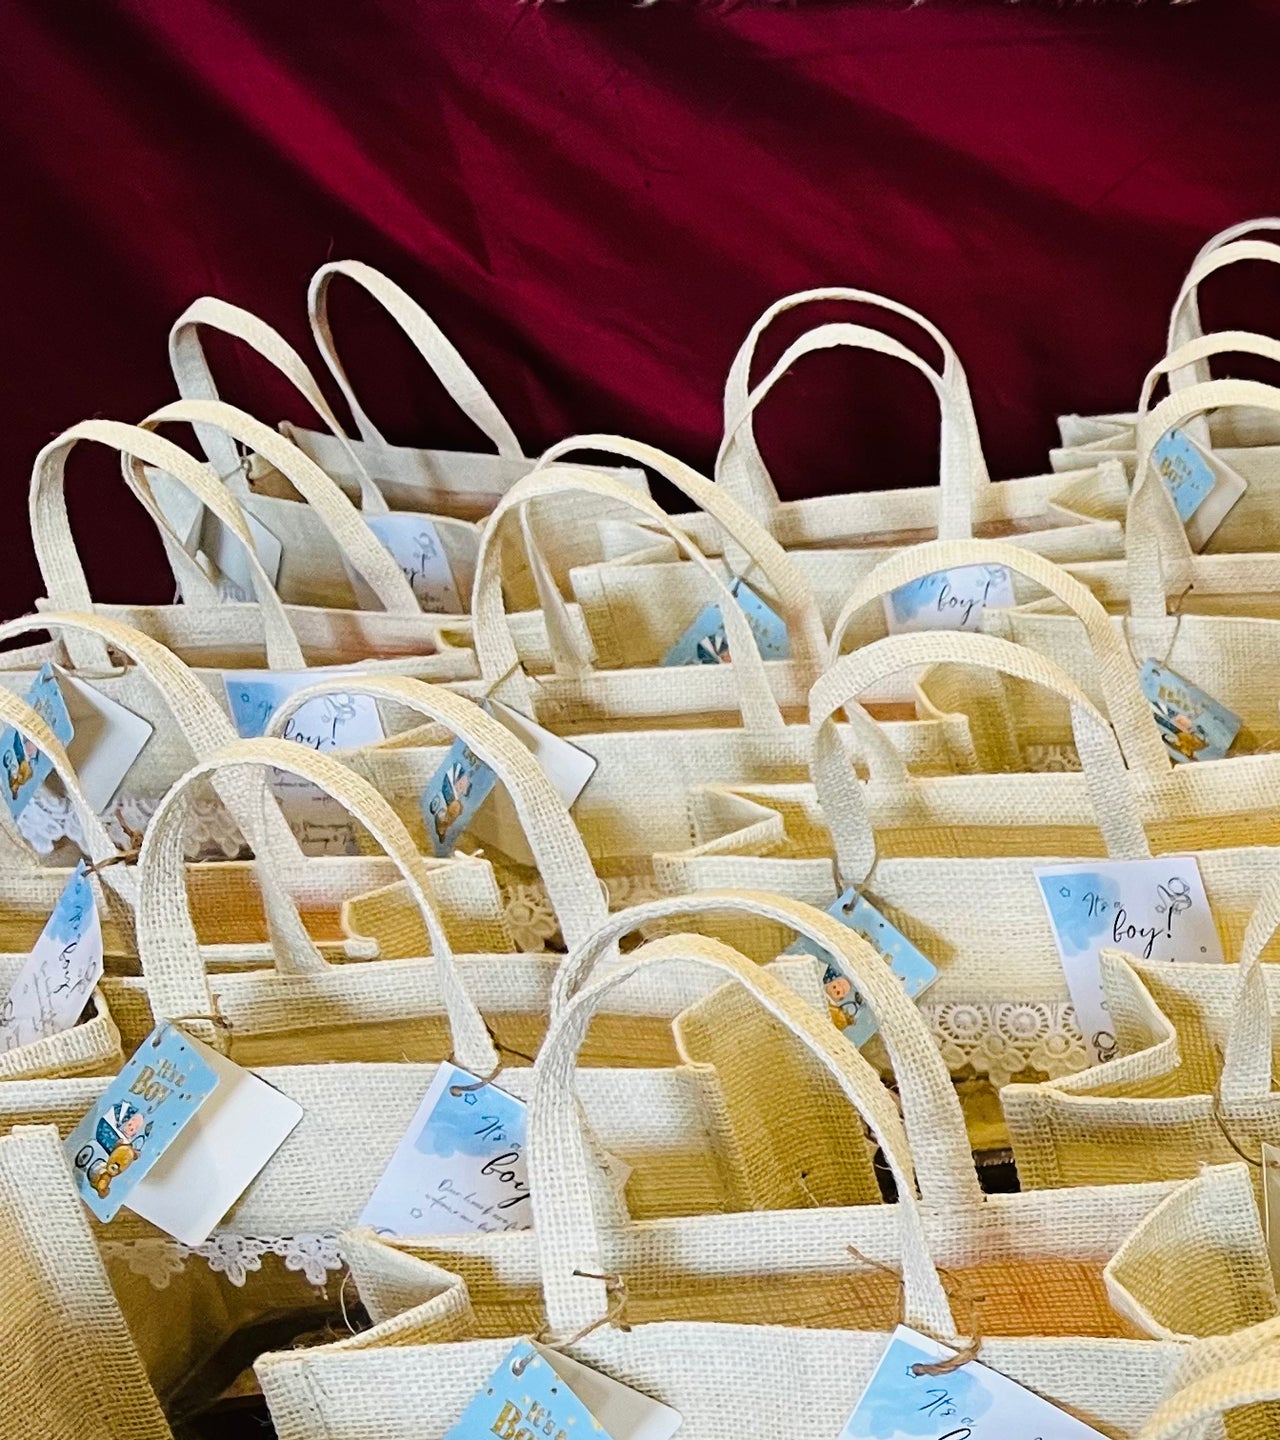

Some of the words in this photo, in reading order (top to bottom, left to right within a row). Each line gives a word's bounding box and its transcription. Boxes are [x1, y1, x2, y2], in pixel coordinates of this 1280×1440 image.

[938, 580, 992, 626] boy!
[1113, 906, 1175, 959] boy!
[129, 1065, 174, 1114] Boy
